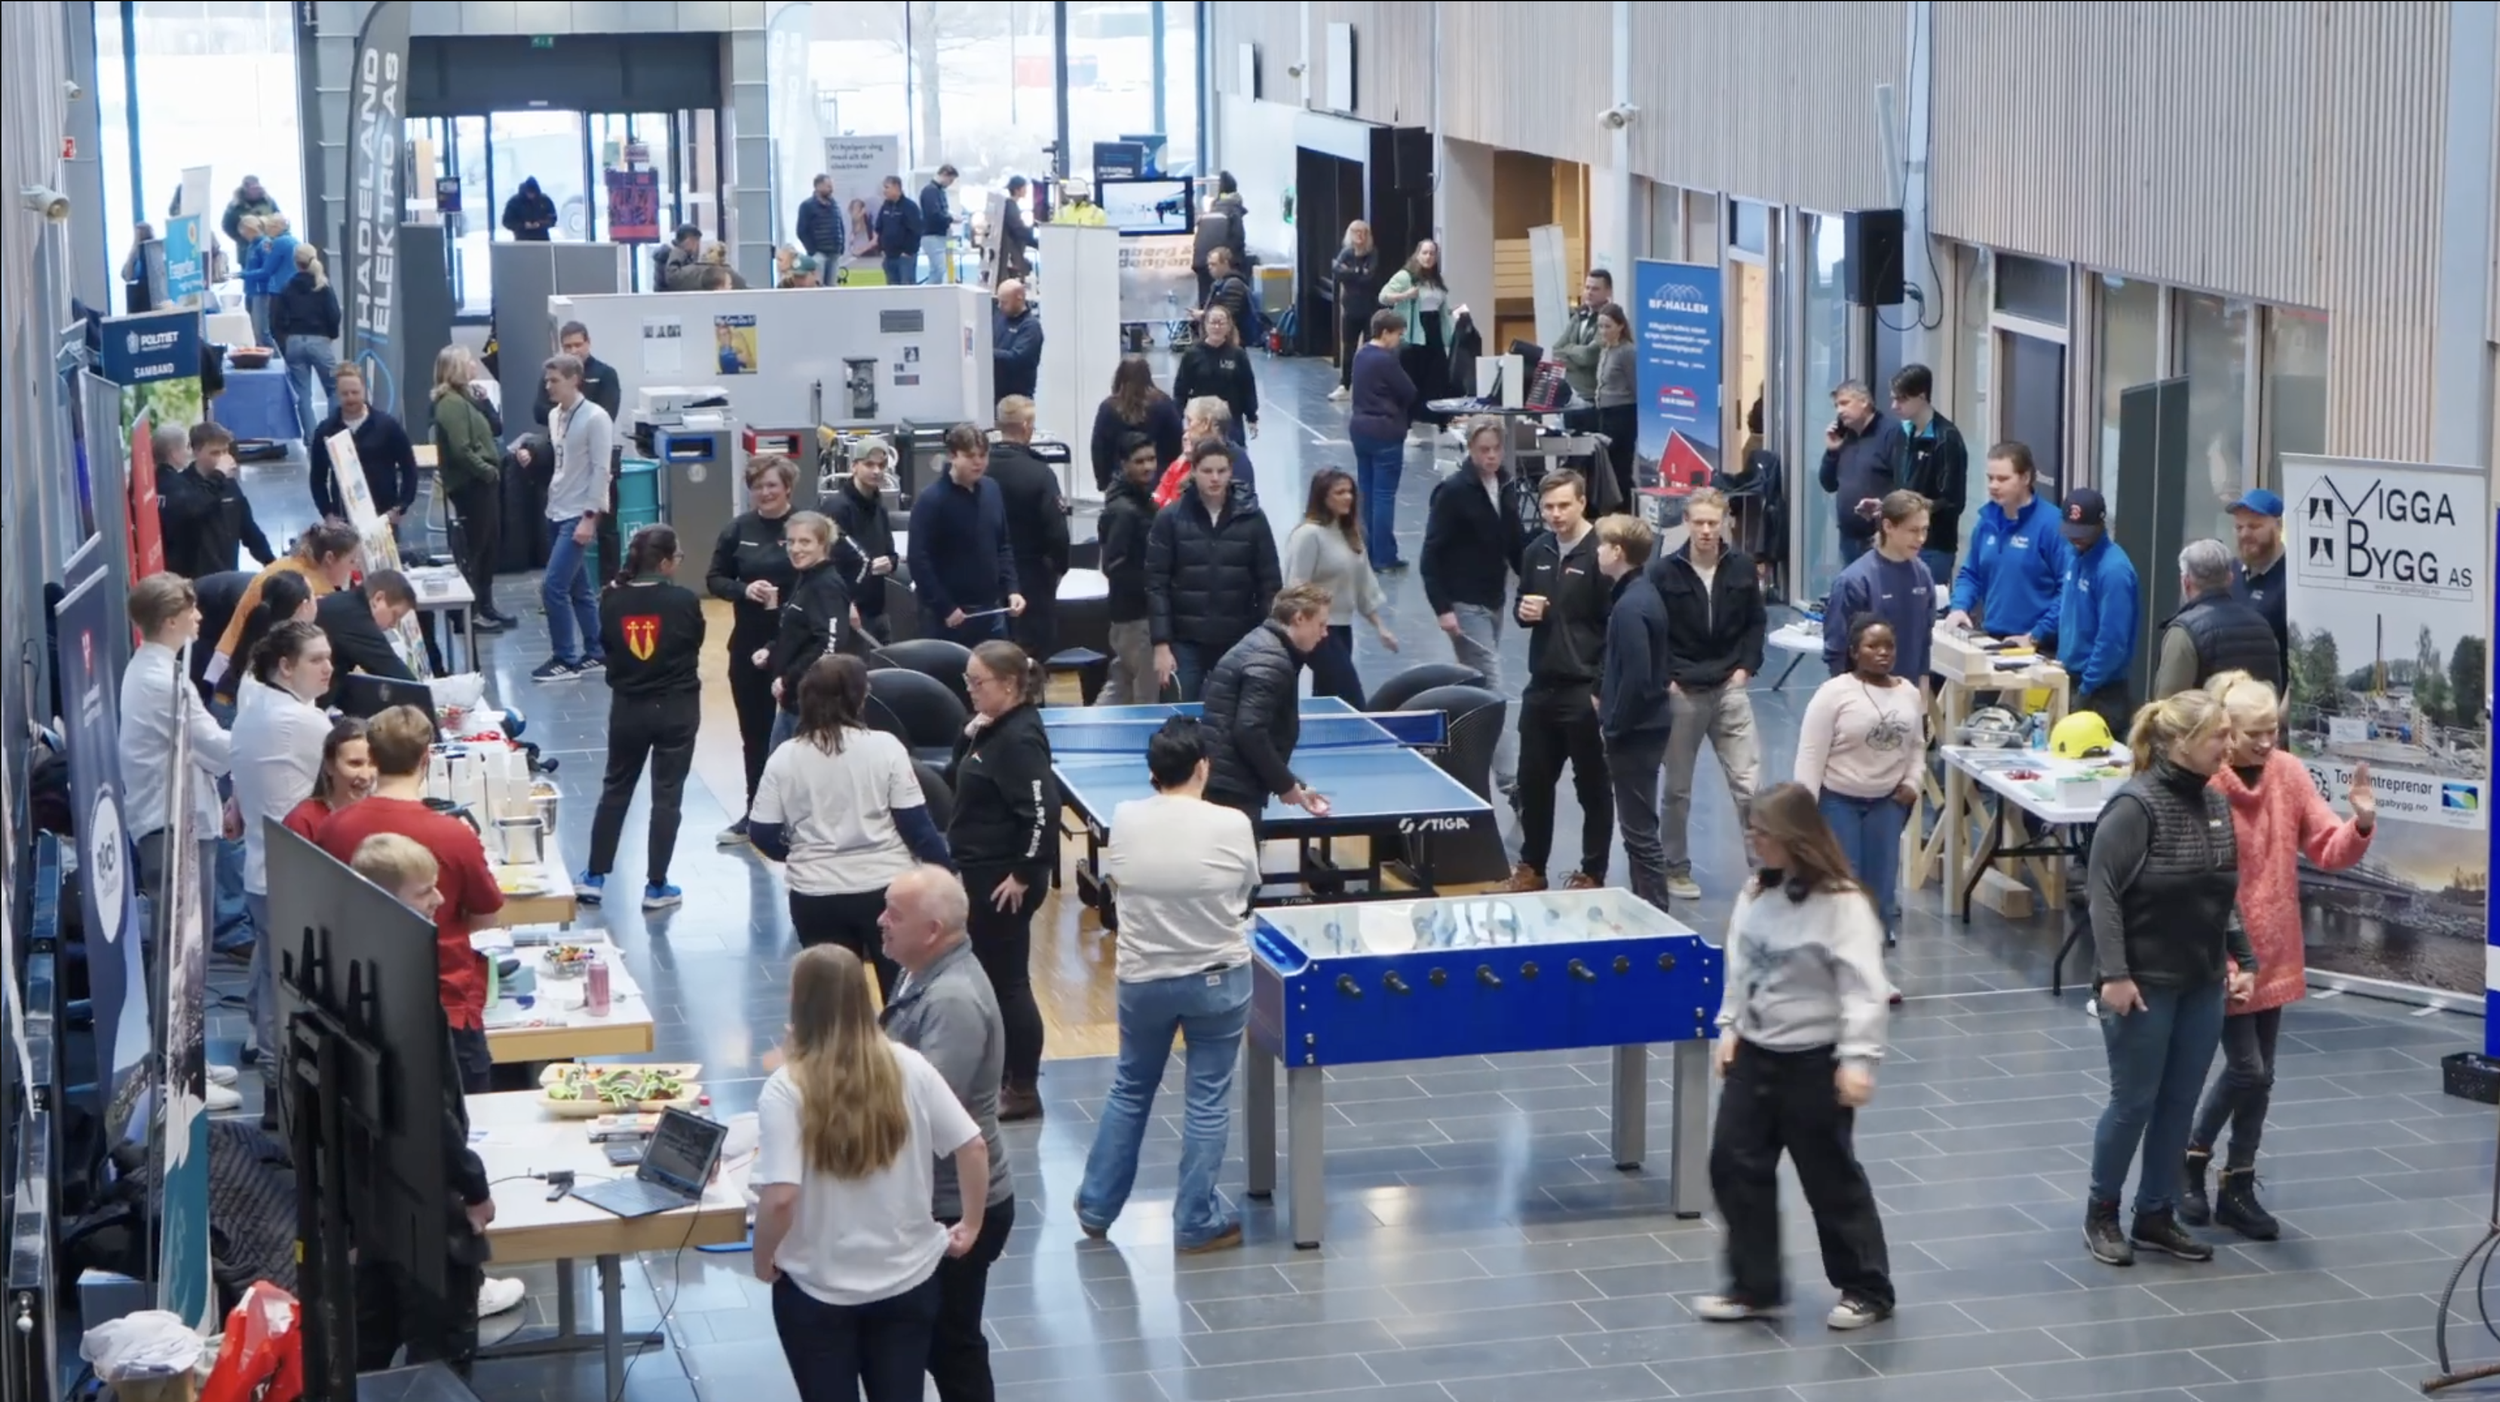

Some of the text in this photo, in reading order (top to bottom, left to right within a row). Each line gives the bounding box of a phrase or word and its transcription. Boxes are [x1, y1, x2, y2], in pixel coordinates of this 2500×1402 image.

[357, 48, 379, 328] HADELAND
[373, 52, 400, 335] ELEKTRO AS
[141, 331, 179, 346] POLITIET
[2324, 475, 2456, 526] VIGGA
[2347, 518, 2473, 588] BYGG AS
[1418, 817, 1470, 831] STIGA
